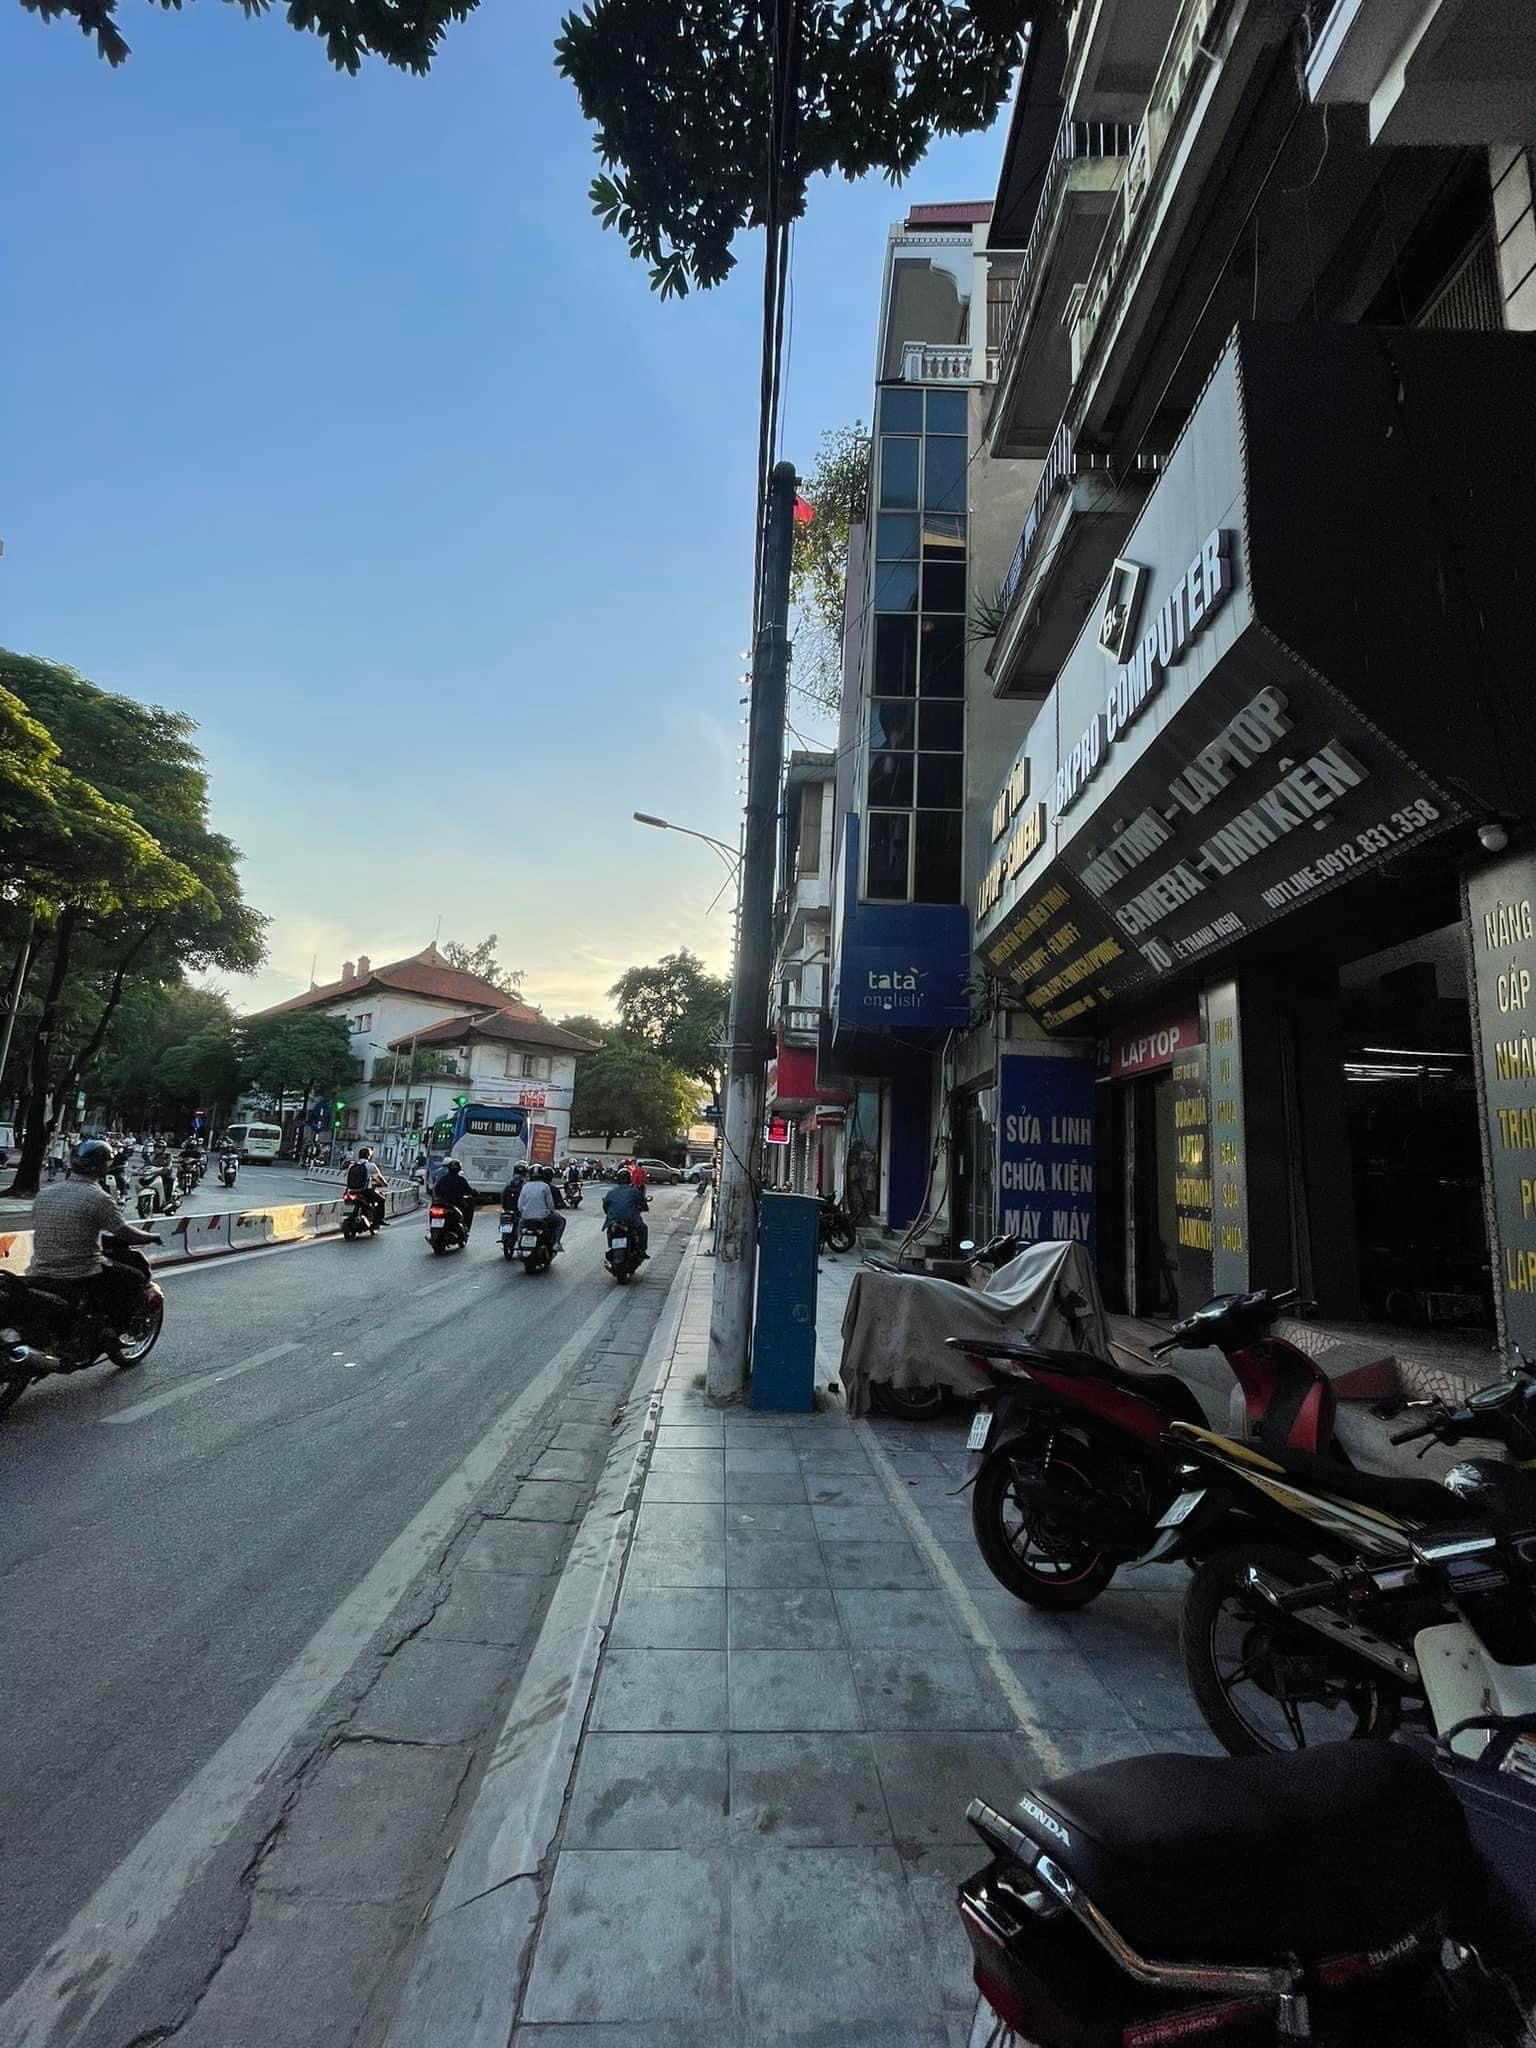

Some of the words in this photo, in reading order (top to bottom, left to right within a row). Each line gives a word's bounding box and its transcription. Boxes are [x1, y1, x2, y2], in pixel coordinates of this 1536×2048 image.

[1055, 712, 1102, 811] BKPRO
[1107, 528, 1231, 742] COMPUTER
[1078, 845, 1124, 898] MÁY
[1112, 804, 1173, 870] TÍNH
[1168, 685, 1294, 815] LAPTOP
[1114, 857, 1209, 936] CAMERA
[1262, 738, 1369, 833] KIỆN
[1139, 937, 1171, 974] 70
[1184, 924, 1217, 953] THANH
[1484, 899, 1534, 952] NÂNG
[1495, 957, 1532, 1014] CẤP
[1120, 1026, 1181, 1068] LAPTOP
[471, 1120, 490, 1131] HUY
[1006, 1105, 1042, 1144] SỬA
[1051, 1115, 1093, 1146] LINH
[1002, 1157, 1046, 1192] CHỮA
[1051, 1159, 1093, 1196] KIỆN
[1004, 1204, 1042, 1241] MÁY
[1052, 1206, 1091, 1241] MÁY
[1018, 1796, 1071, 1848] HONDA
